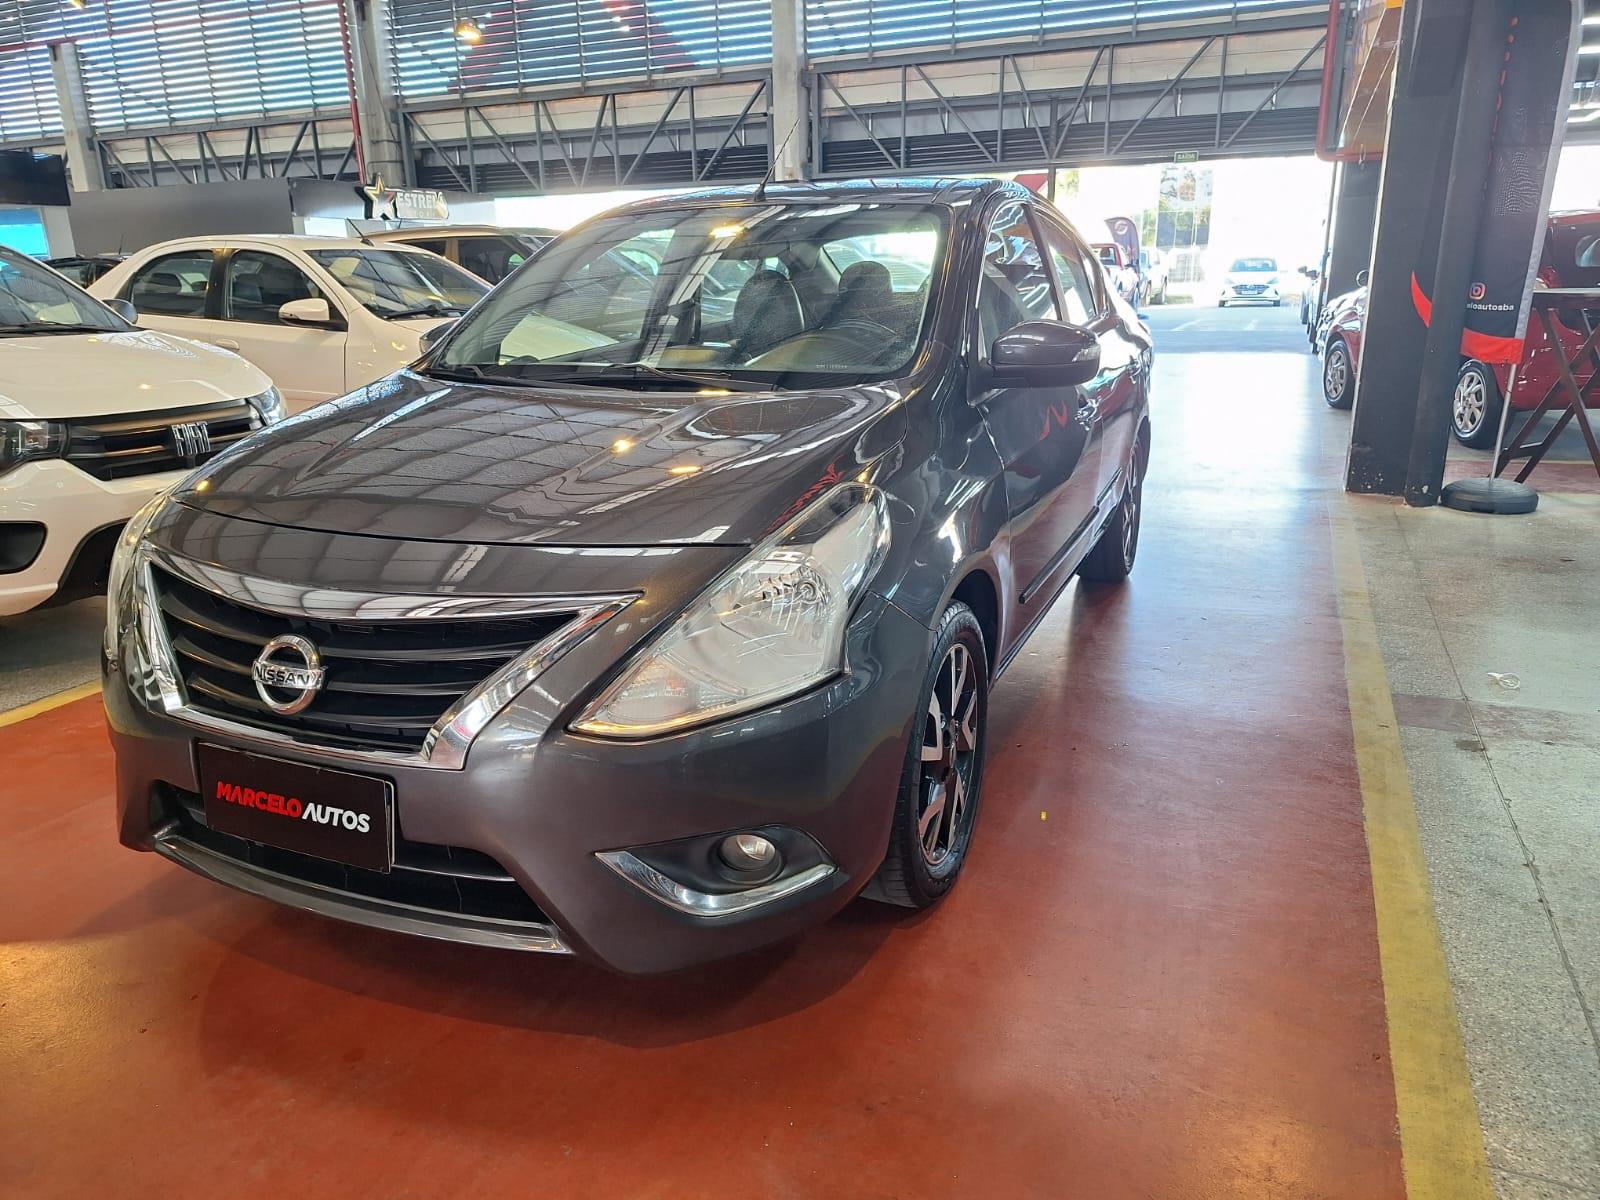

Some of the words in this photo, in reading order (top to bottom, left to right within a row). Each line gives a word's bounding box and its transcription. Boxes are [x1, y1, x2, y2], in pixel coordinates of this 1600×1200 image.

[171, 420, 211, 457] FIAT
[252, 661, 311, 686] NISSAN
[216, 780, 302, 818] MARCELO
[302, 802, 371, 833] AUTOS
